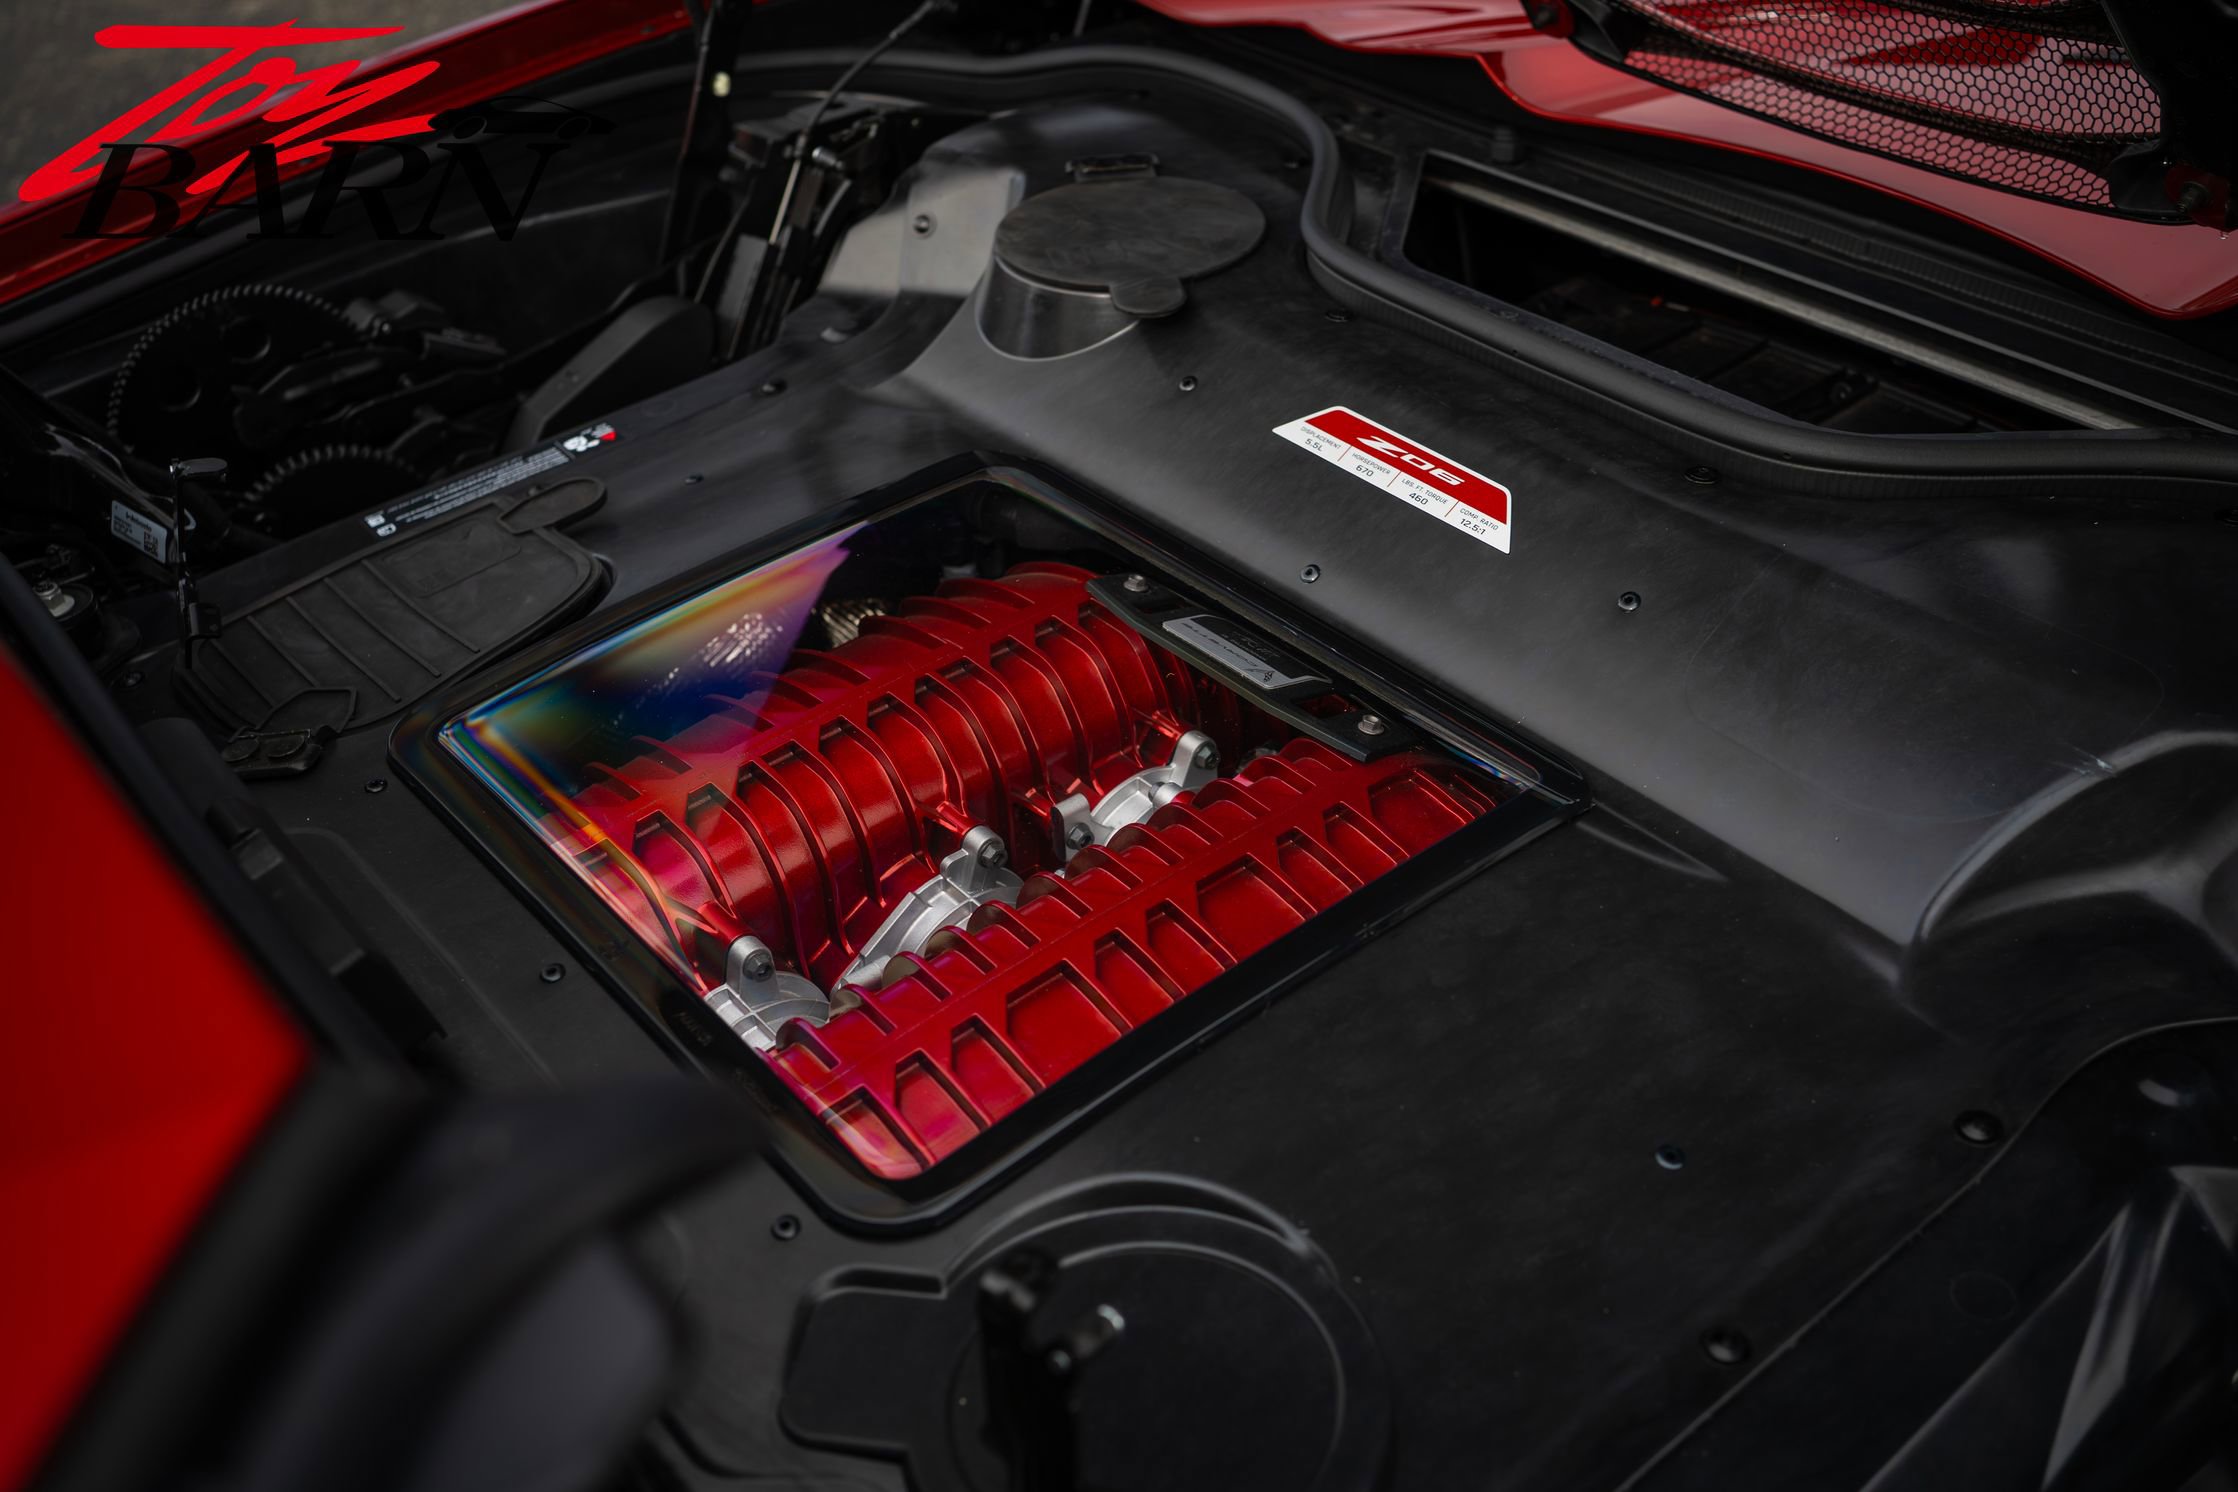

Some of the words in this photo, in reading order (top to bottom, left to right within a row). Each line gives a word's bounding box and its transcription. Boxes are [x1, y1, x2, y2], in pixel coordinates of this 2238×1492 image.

[1300, 426, 1342, 450] DISPLACEMENT
[1305, 438, 1324, 452] 5.5L
[1352, 453, 1392, 475] HORSEPOWER
[1356, 435, 1466, 486] Z06
[1355, 464, 1375, 478] 670
[1401, 478, 1415, 488] LBS.
[1425, 489, 1449, 505] TORQUE
[1408, 492, 1429, 506] 460
[1460, 518, 1487, 535] 12.5:1
[1480, 518, 1500, 531] RATIO
